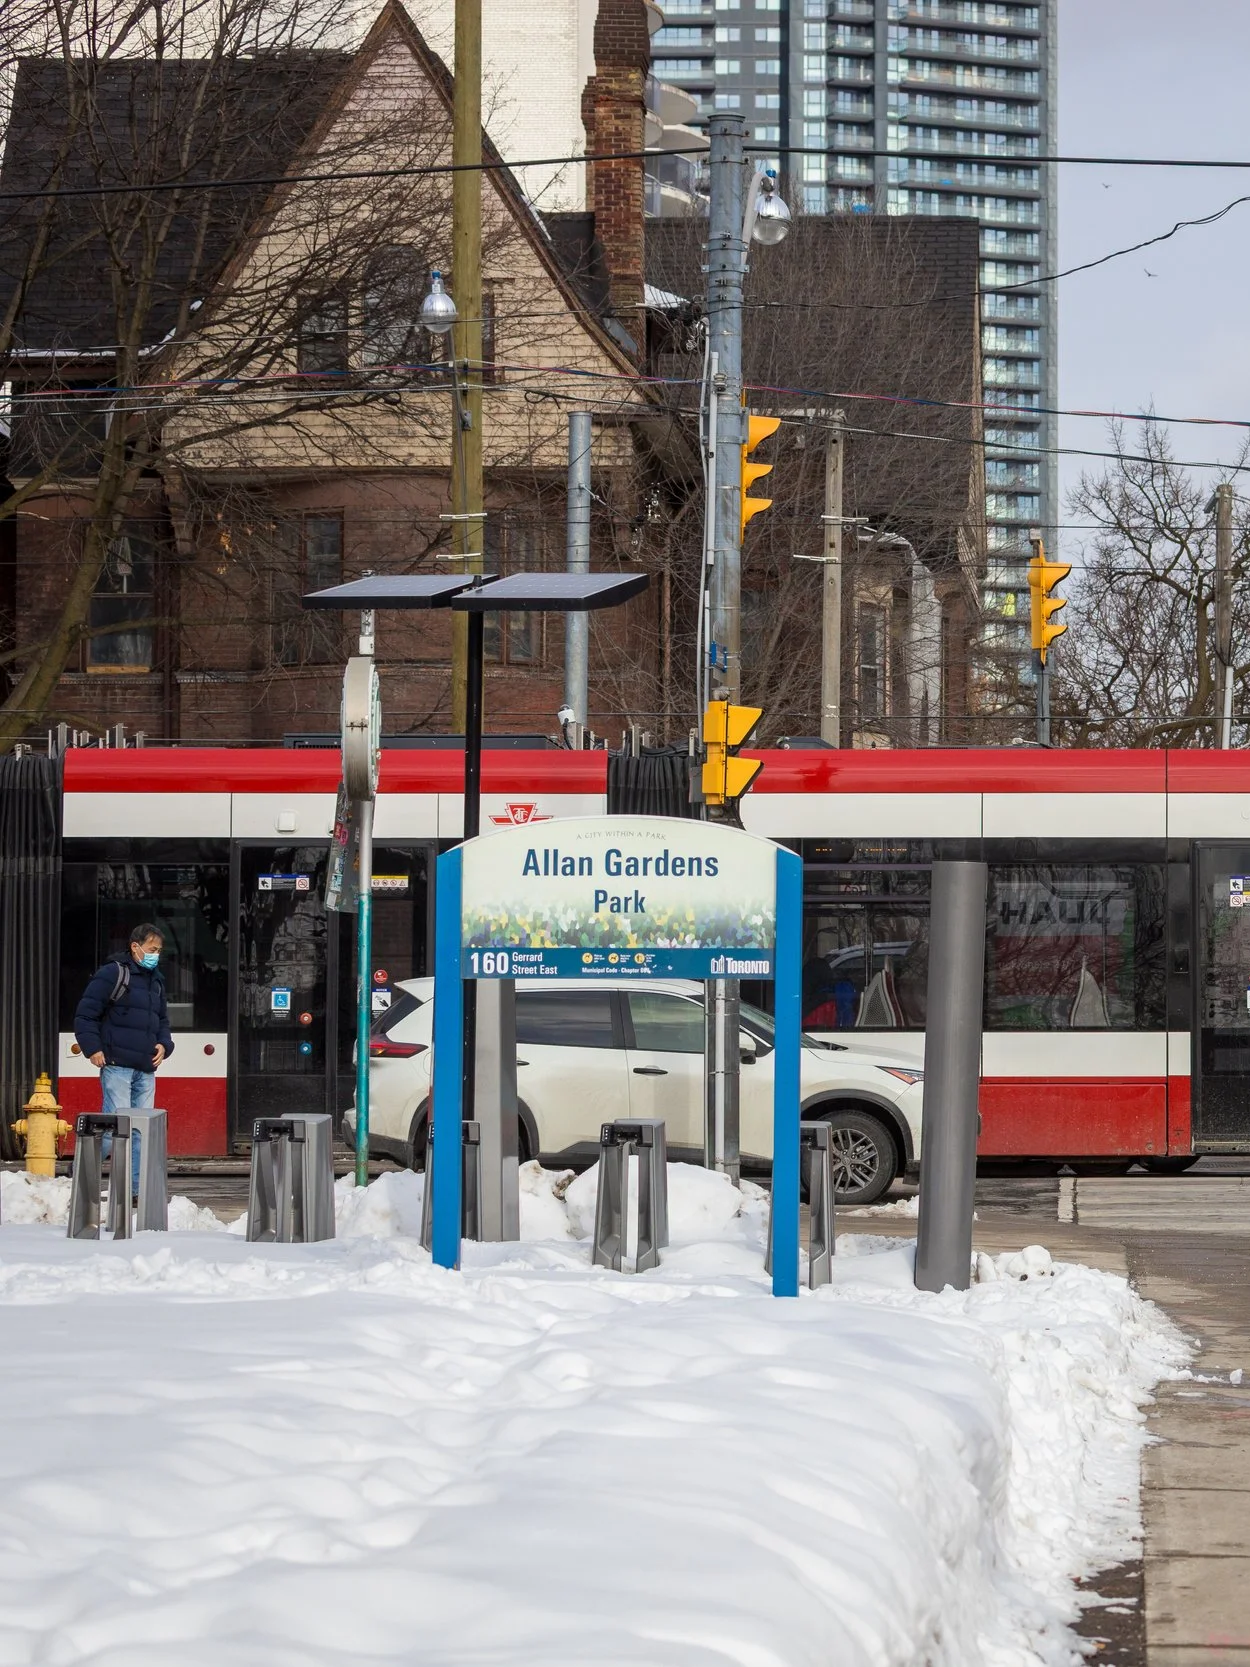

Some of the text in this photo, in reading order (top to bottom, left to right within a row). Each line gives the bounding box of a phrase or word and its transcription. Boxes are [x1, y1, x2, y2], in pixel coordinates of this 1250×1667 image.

[645, 831, 667, 840] PARK
[522, 849, 719, 877] Allan Gardens
[594, 889, 646, 913] Park
[470, 952, 509, 974] 160
[512, 952, 543, 962] Gerrard
[512, 965, 558, 974] Street East
[726, 958, 770, 974] TORONTO
